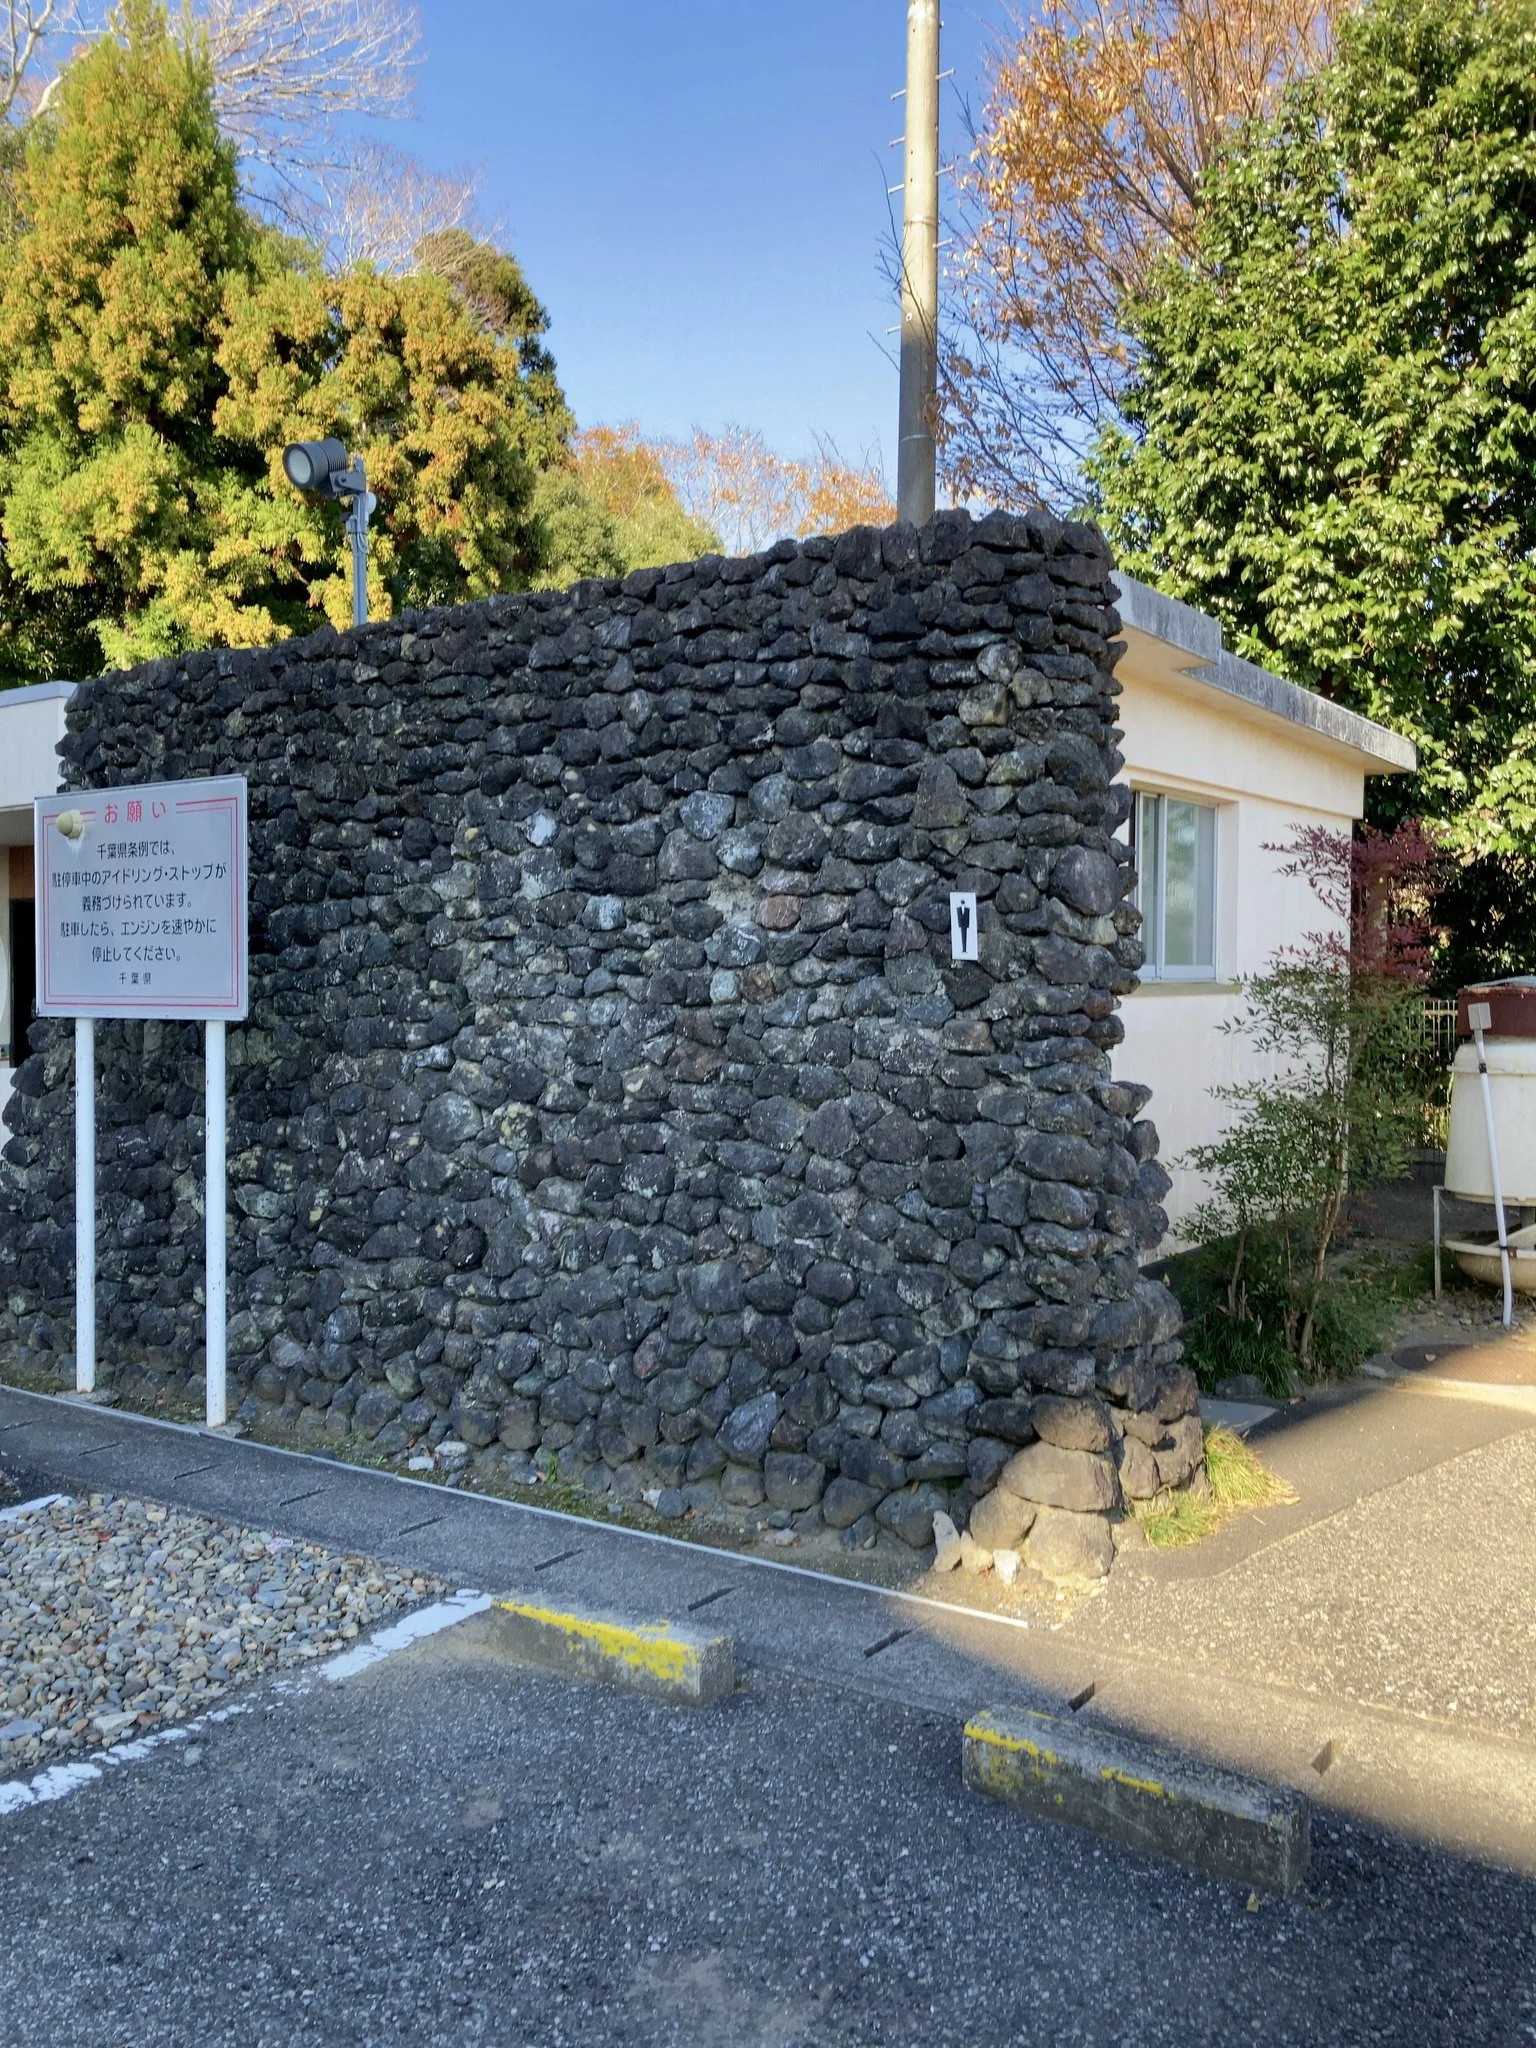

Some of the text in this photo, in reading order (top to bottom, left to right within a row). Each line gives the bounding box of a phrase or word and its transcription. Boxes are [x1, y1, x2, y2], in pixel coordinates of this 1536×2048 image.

[104, 800, 167, 824] お願い
[97, 840, 175, 860] 千葉県条例では、
[52, 864, 227, 888] 駐停車中のアイドリング・ストップが
[82, 892, 192, 912] 義務づけられています。
[60, 918, 217, 937] 駐車したら、エンジンを速やかに
[92, 946, 182, 962] 停止してください。
[119, 972, 152, 985] 千葉県
